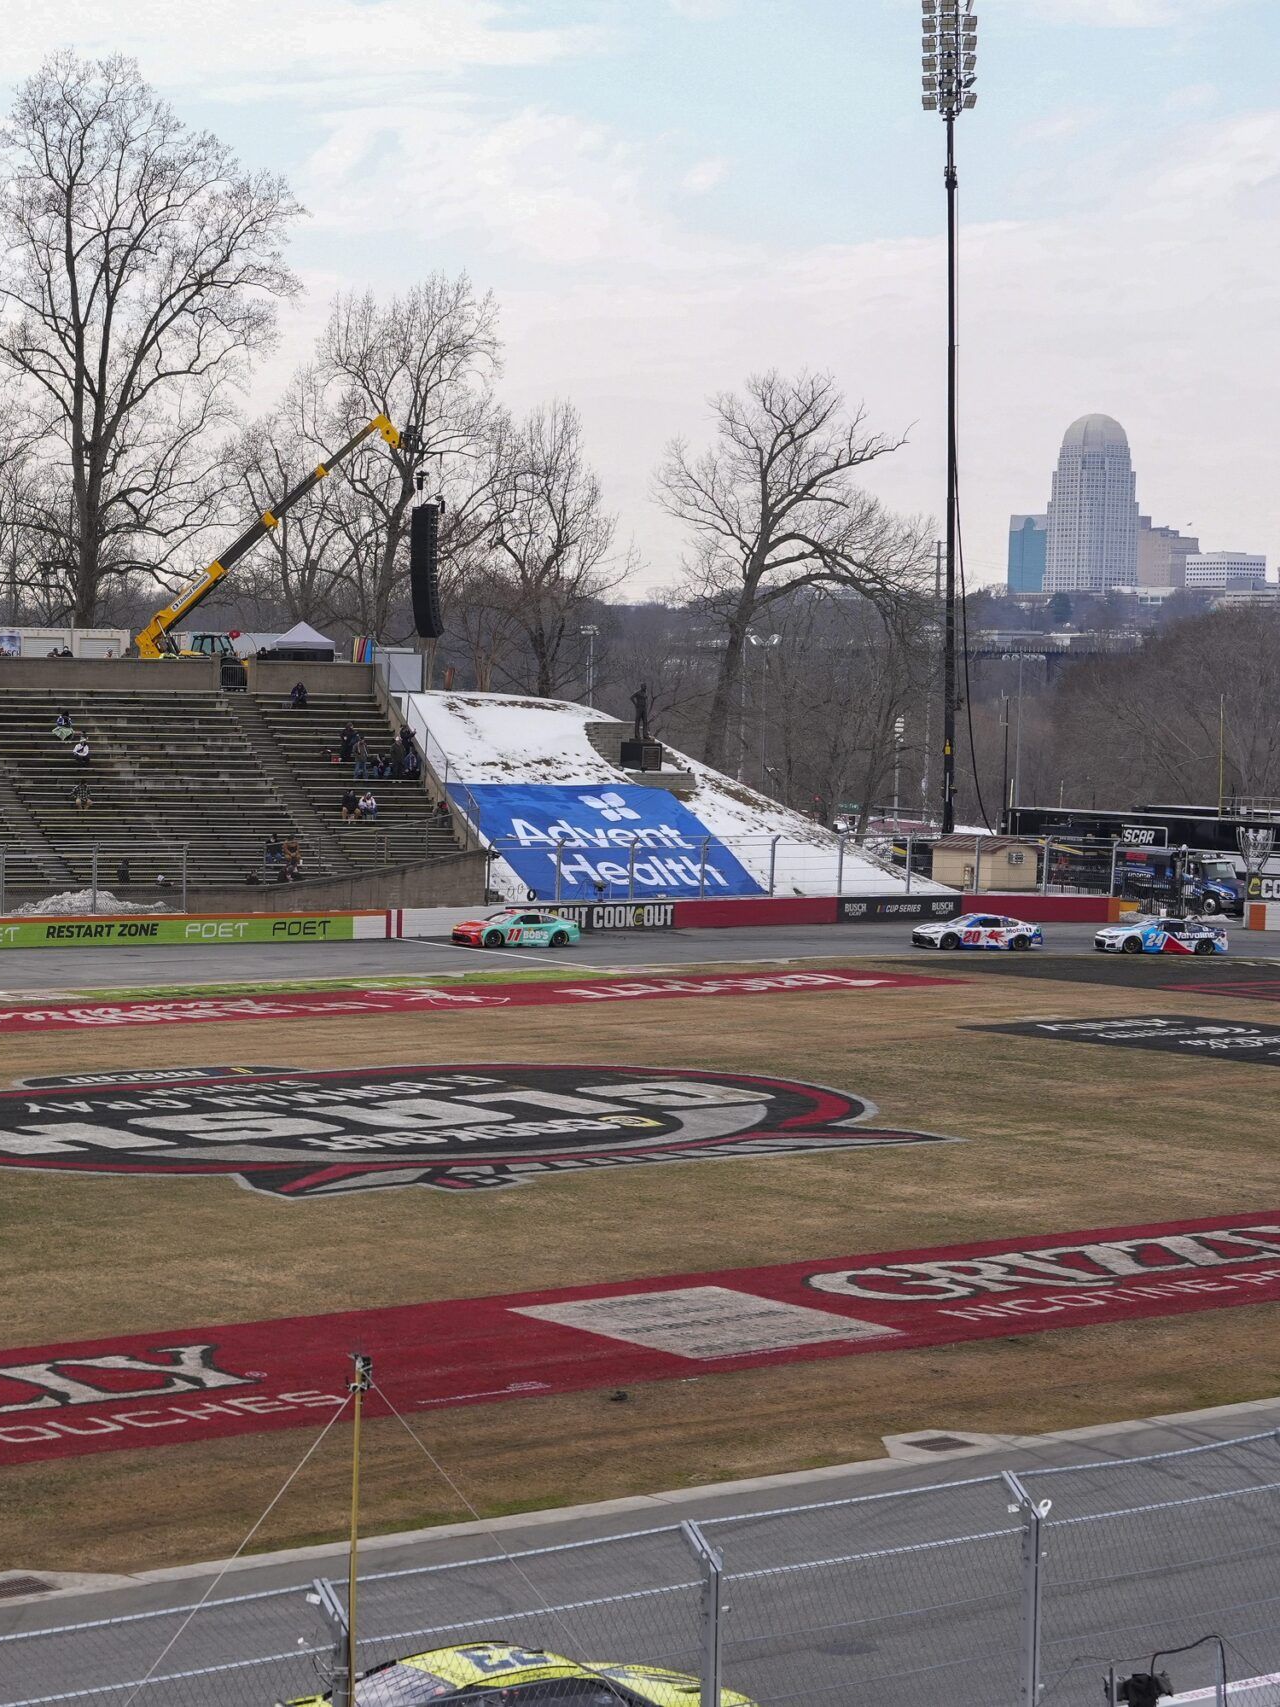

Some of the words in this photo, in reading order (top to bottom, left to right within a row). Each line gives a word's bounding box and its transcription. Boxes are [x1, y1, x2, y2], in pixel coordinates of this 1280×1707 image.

[510, 818, 695, 849] Advent
[1123, 829, 1155, 844] SCAR
[547, 853, 730, 886] Health
[844, 903, 867, 912] BUSCH
[886, 904, 899, 912] CUP
[899, 904, 922, 912] SERIES
[931, 901, 954, 911] BUSCH
[593, 906, 635, 928] COOK
[644, 904, 674, 926] OUT
[46, 924, 114, 938] RESTART
[117, 923, 159, 937] ZONE
[185, 922, 248, 938] POET
[272, 920, 331, 936] POET
[506, 928, 523, 943] 11
[963, 930, 981, 943] 20
[1174, 931, 1216, 939] Valvoline
[1147, 933, 1163, 946] 24
[65, 1070, 210, 1083] NASCAR
[441, 1074, 506, 1087] AT
[138, 1080, 323, 1096] STADIUM
[195, 1081, 455, 1107] BOWMAN
[25, 1097, 193, 1113] GRAY
[803, 1225, 1280, 1300] GRIZZ
[939, 1280, 1238, 1321] NICOTINE
